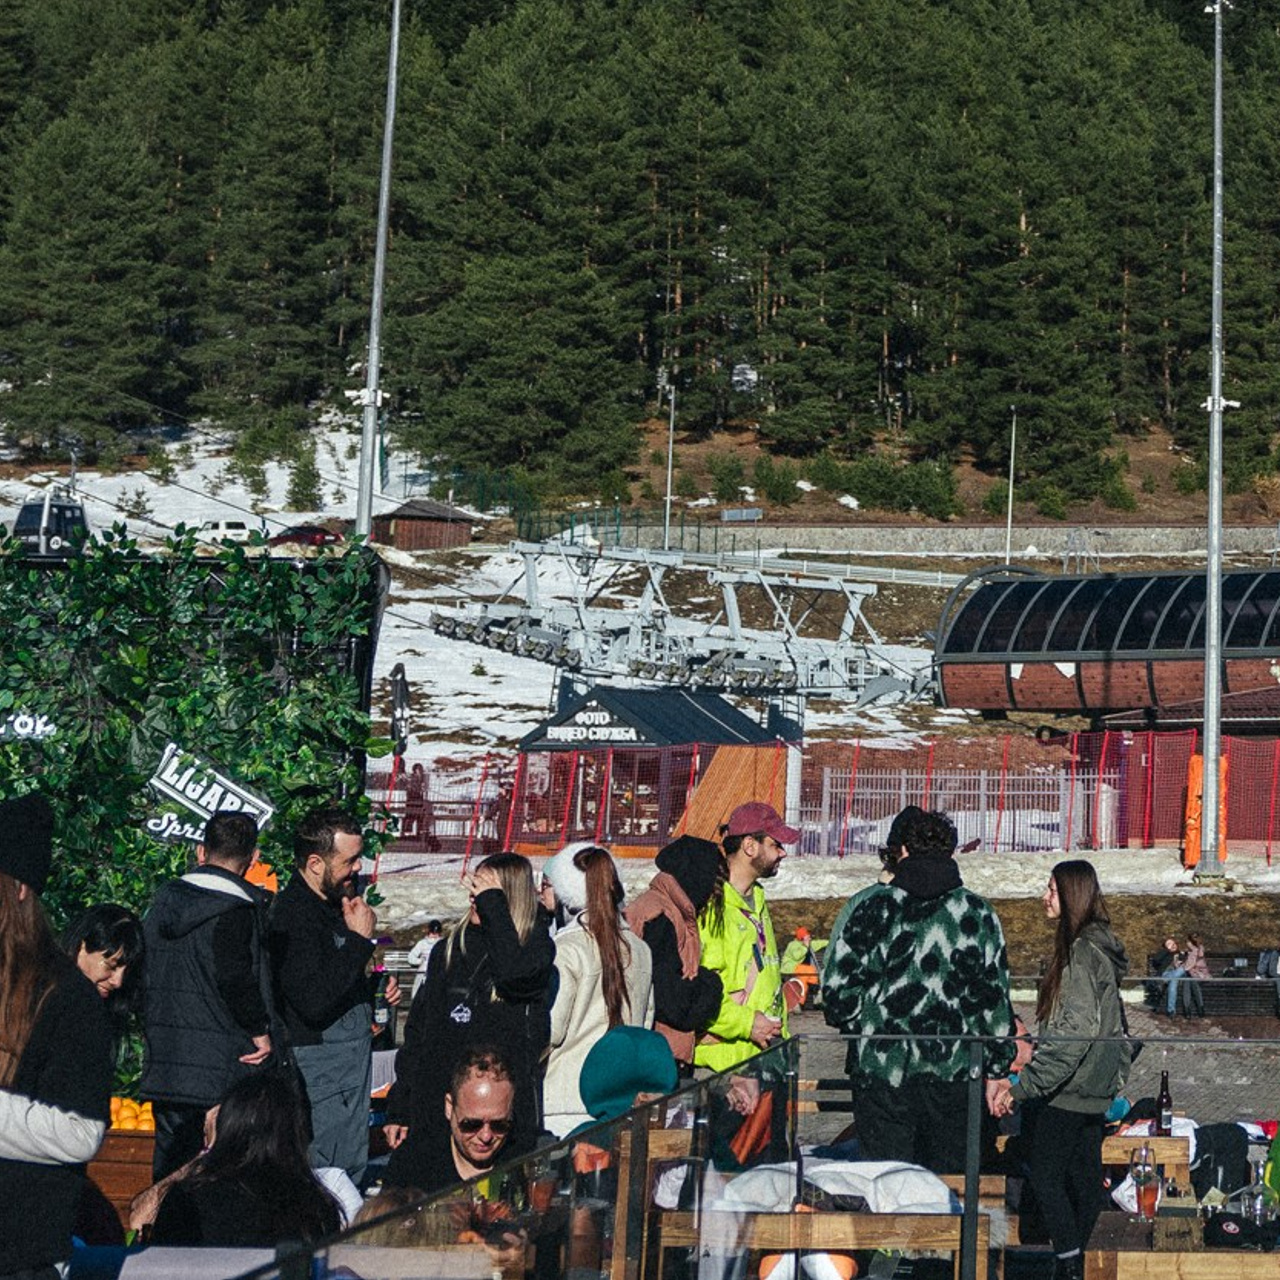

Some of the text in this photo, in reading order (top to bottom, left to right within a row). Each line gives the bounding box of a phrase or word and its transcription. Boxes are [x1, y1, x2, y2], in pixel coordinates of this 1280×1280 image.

[574, 712, 611, 726] ФОТО
[546, 726, 638, 742] ВИДЕО СЛУЖБА
[146, 812, 207, 841] Spri
